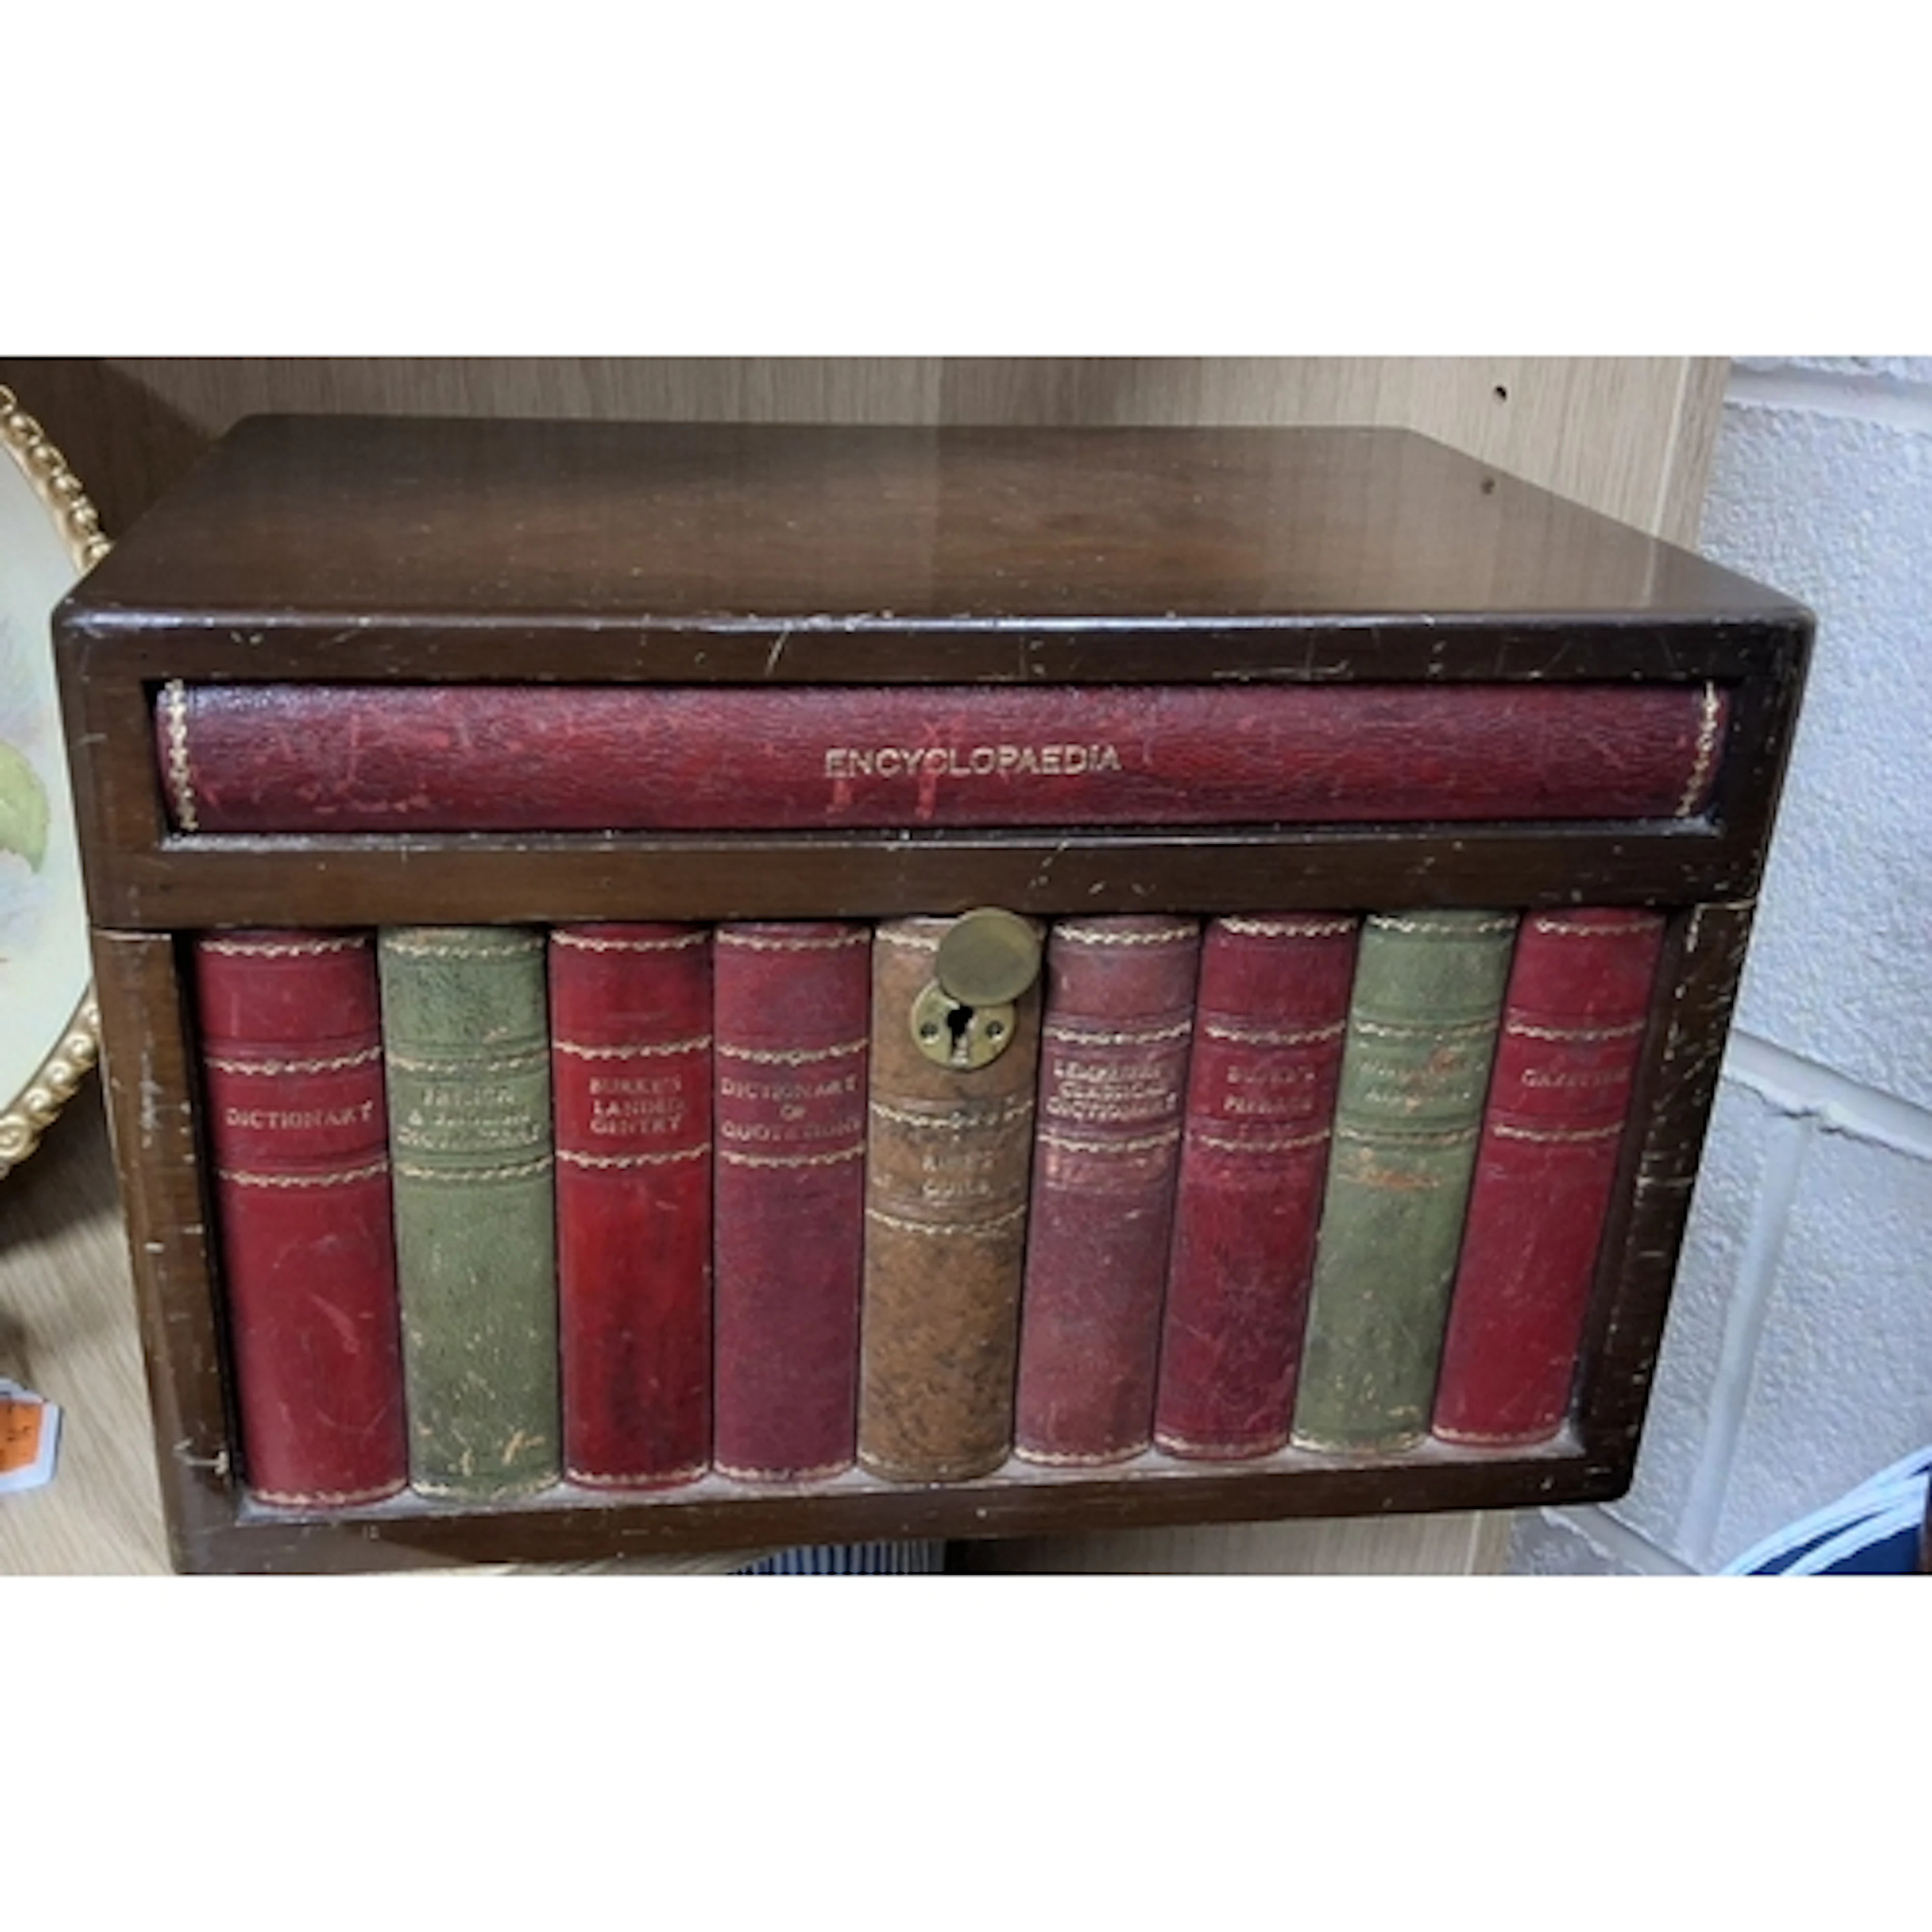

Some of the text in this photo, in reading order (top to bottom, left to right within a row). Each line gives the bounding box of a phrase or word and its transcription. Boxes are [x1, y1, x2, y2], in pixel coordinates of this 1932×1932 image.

[825, 745, 1122, 778] ENCYCLOPAEDIA
[588, 1074, 683, 1096] BURKE'S
[720, 1074, 860, 1101] DICTIONARY
[225, 1101, 374, 1130] DICTIONARY
